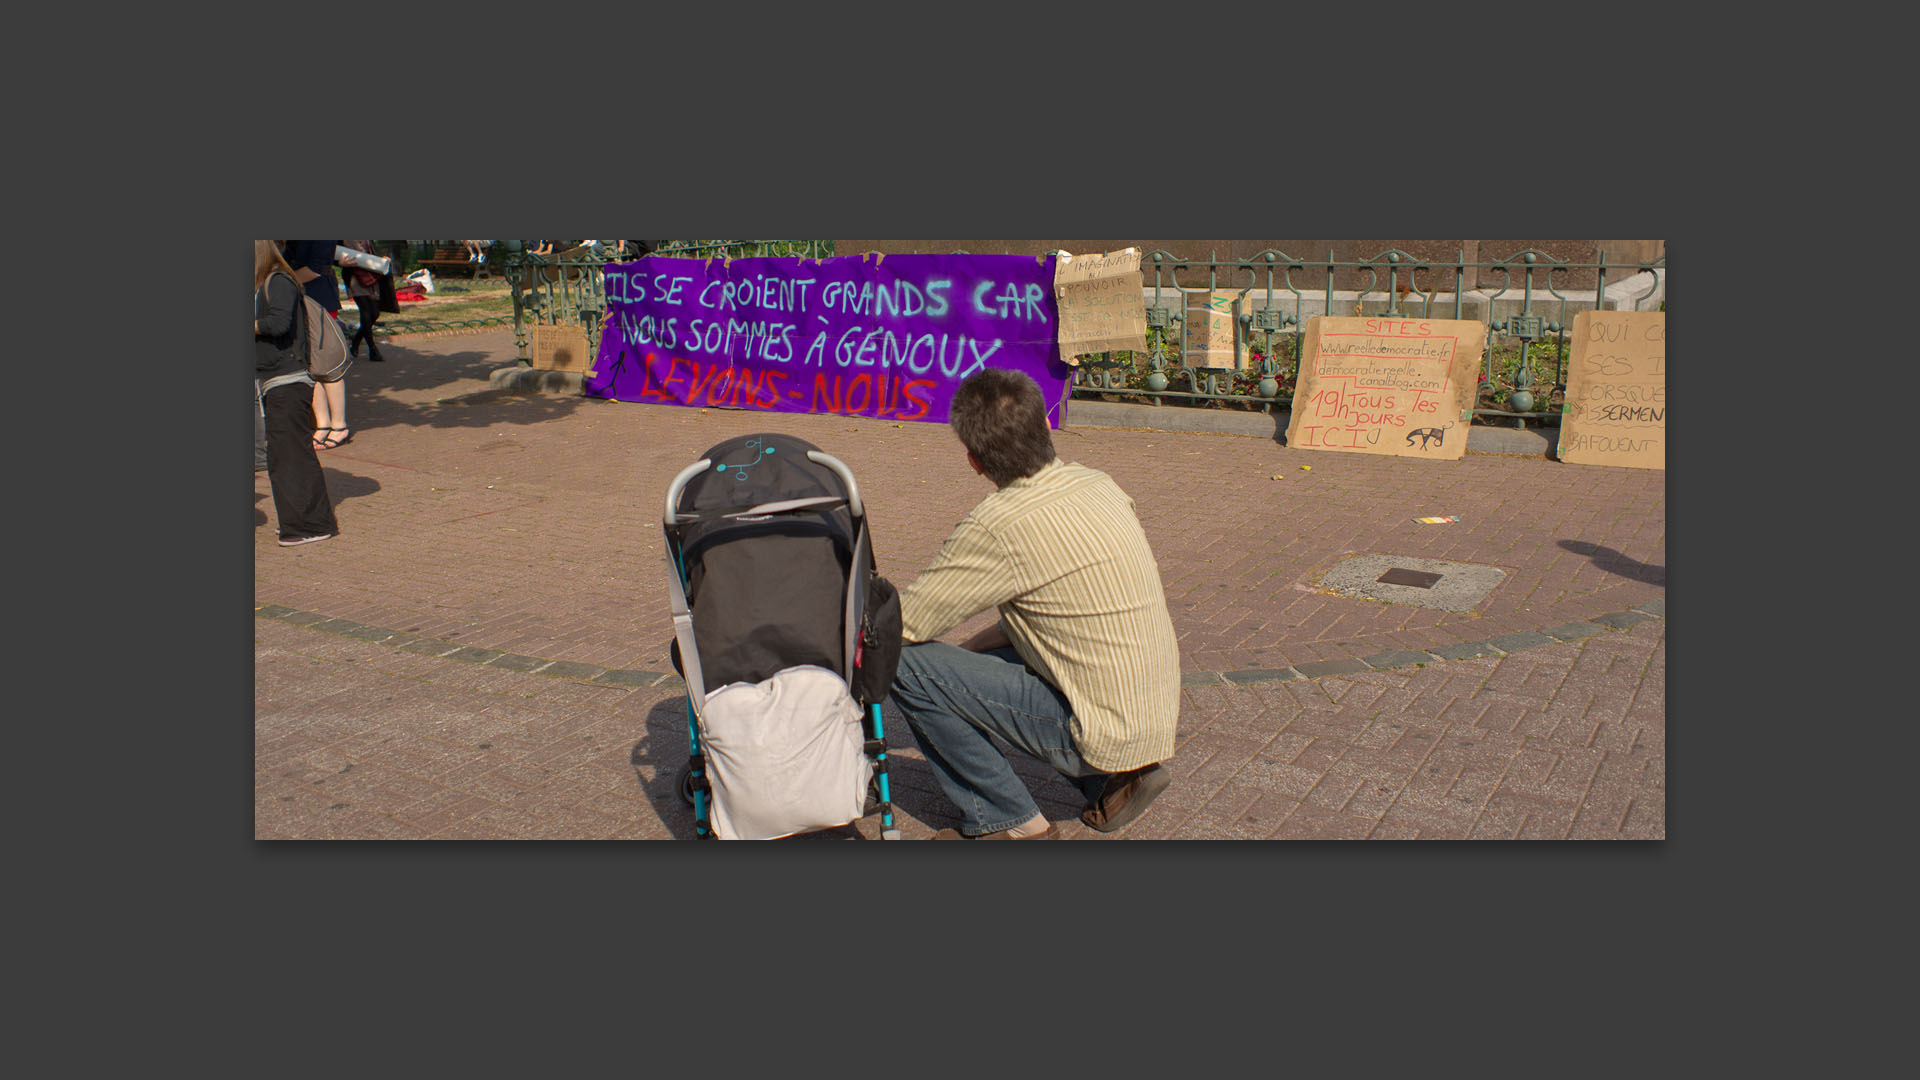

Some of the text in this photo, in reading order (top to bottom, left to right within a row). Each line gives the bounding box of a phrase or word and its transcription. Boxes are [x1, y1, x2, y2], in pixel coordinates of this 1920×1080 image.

[607, 273, 647, 304] ILS
[653, 274, 693, 305] SE
[823, 279, 951, 316] GRANDS
[972, 281, 1048, 324] CAR
[620, 311, 677, 349] NOUS
[684, 317, 797, 362] SOMMES
[804, 316, 829, 367] À
[1365, 319, 1432, 336] SITES
[1586, 354, 1634, 377] SES
[1359, 374, 1440, 392] canalblog.com
[1578, 384, 1665, 404] LORSQUE
[1310, 381, 1349, 420] 19h
[1300, 425, 1368, 449] ICI
[1567, 431, 1658, 452] BAFOUENT
